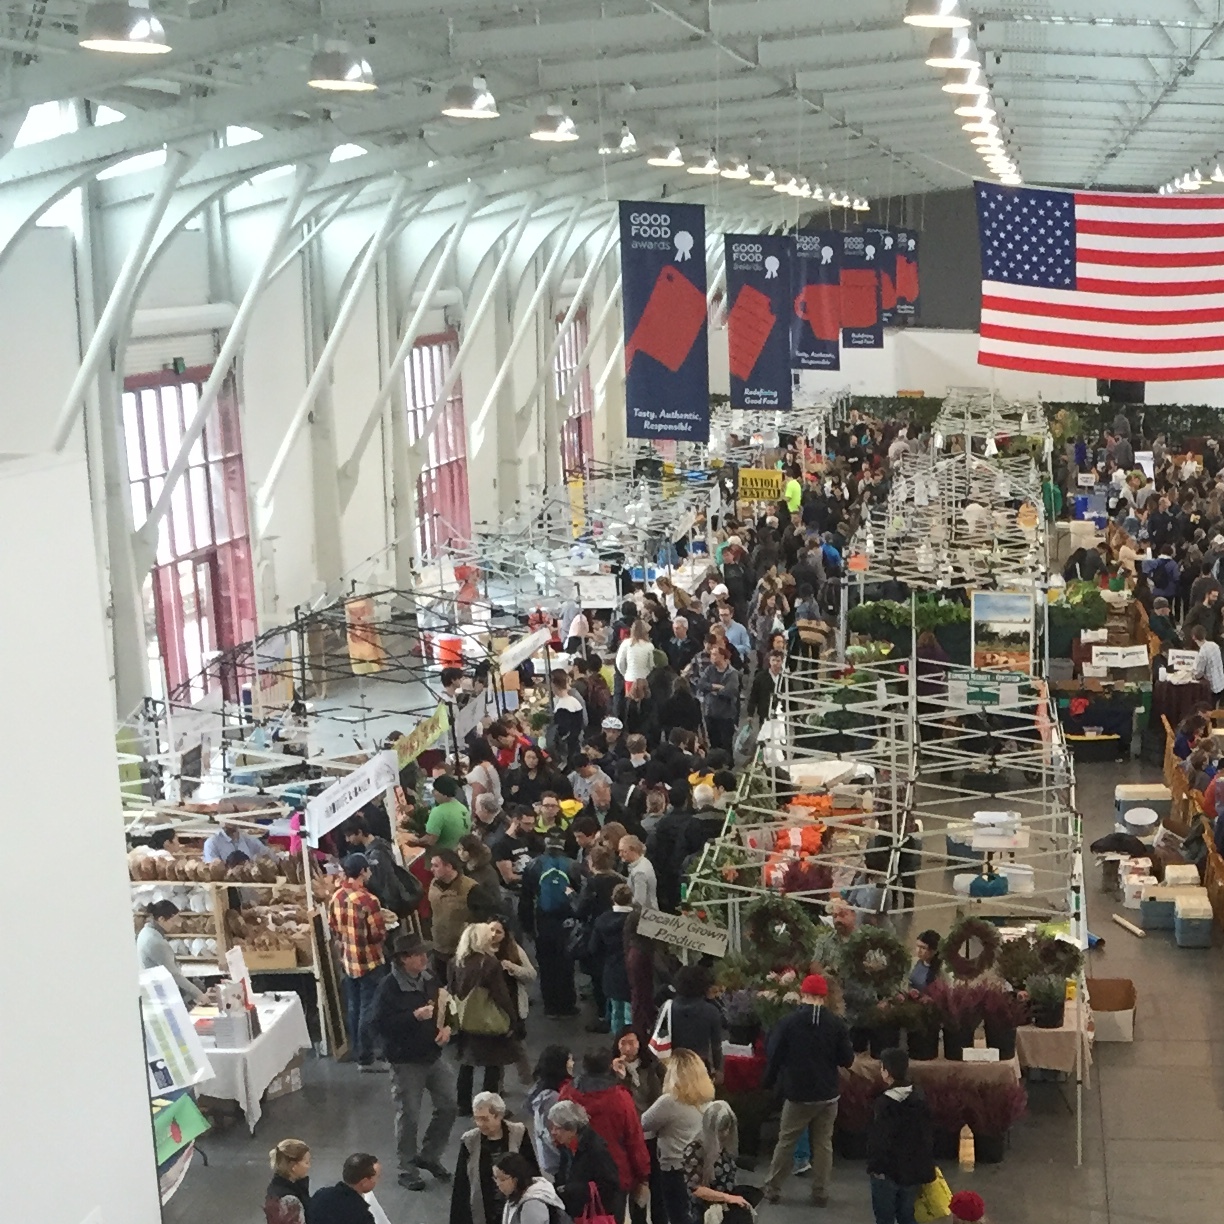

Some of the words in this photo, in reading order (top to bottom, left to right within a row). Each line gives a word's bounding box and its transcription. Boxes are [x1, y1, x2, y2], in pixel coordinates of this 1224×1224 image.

[630, 212, 671, 226] GOOD
[631, 226, 671, 238] FOOD
[631, 241, 671, 250] awards
[732, 243, 762, 253] GOOD
[732, 253, 763, 262] FOOD
[643, 420, 692, 432] Responsible
[641, 909, 685, 932] Locally
[687, 922, 727, 942] Grown
[654, 928, 706, 949] Produce
